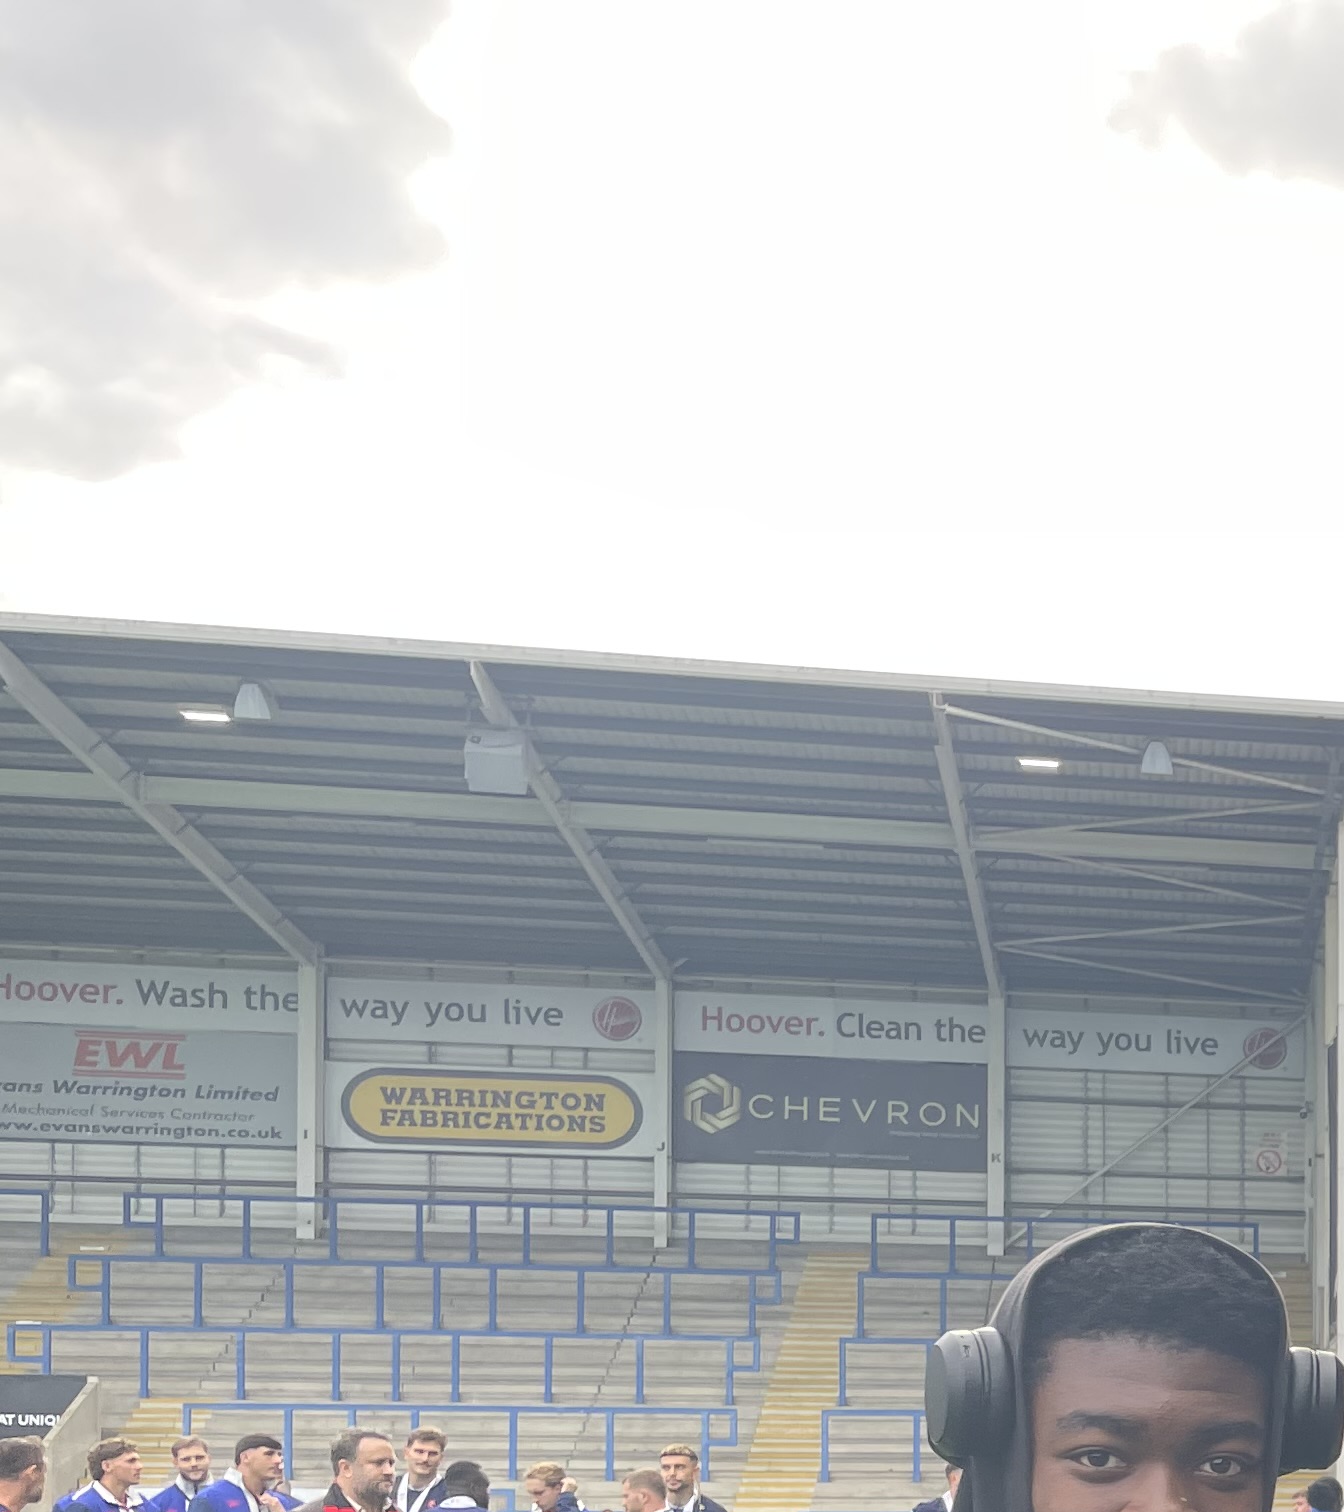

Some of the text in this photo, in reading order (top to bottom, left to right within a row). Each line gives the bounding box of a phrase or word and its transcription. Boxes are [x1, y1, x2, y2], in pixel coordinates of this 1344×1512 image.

[135, 979, 228, 1010] Wash
[244, 984, 299, 1013] the
[340, 998, 410, 1027] way
[424, 1000, 488, 1028] you
[504, 998, 564, 1027] live
[701, 1005, 1219, 1056] Hoover. Clean the way you live
[73, 1038, 187, 1071] EWL
[53, 1079, 186, 1102] Warrington
[195, 1085, 280, 1102] Limited
[379, 1086, 607, 1112] WARRINGTON
[2, 1102, 256, 1122] Mechanical Services Contractor
[379, 1108, 607, 1134] FABRICATIONS
[749, 1094, 980, 1129] CHEVRON
